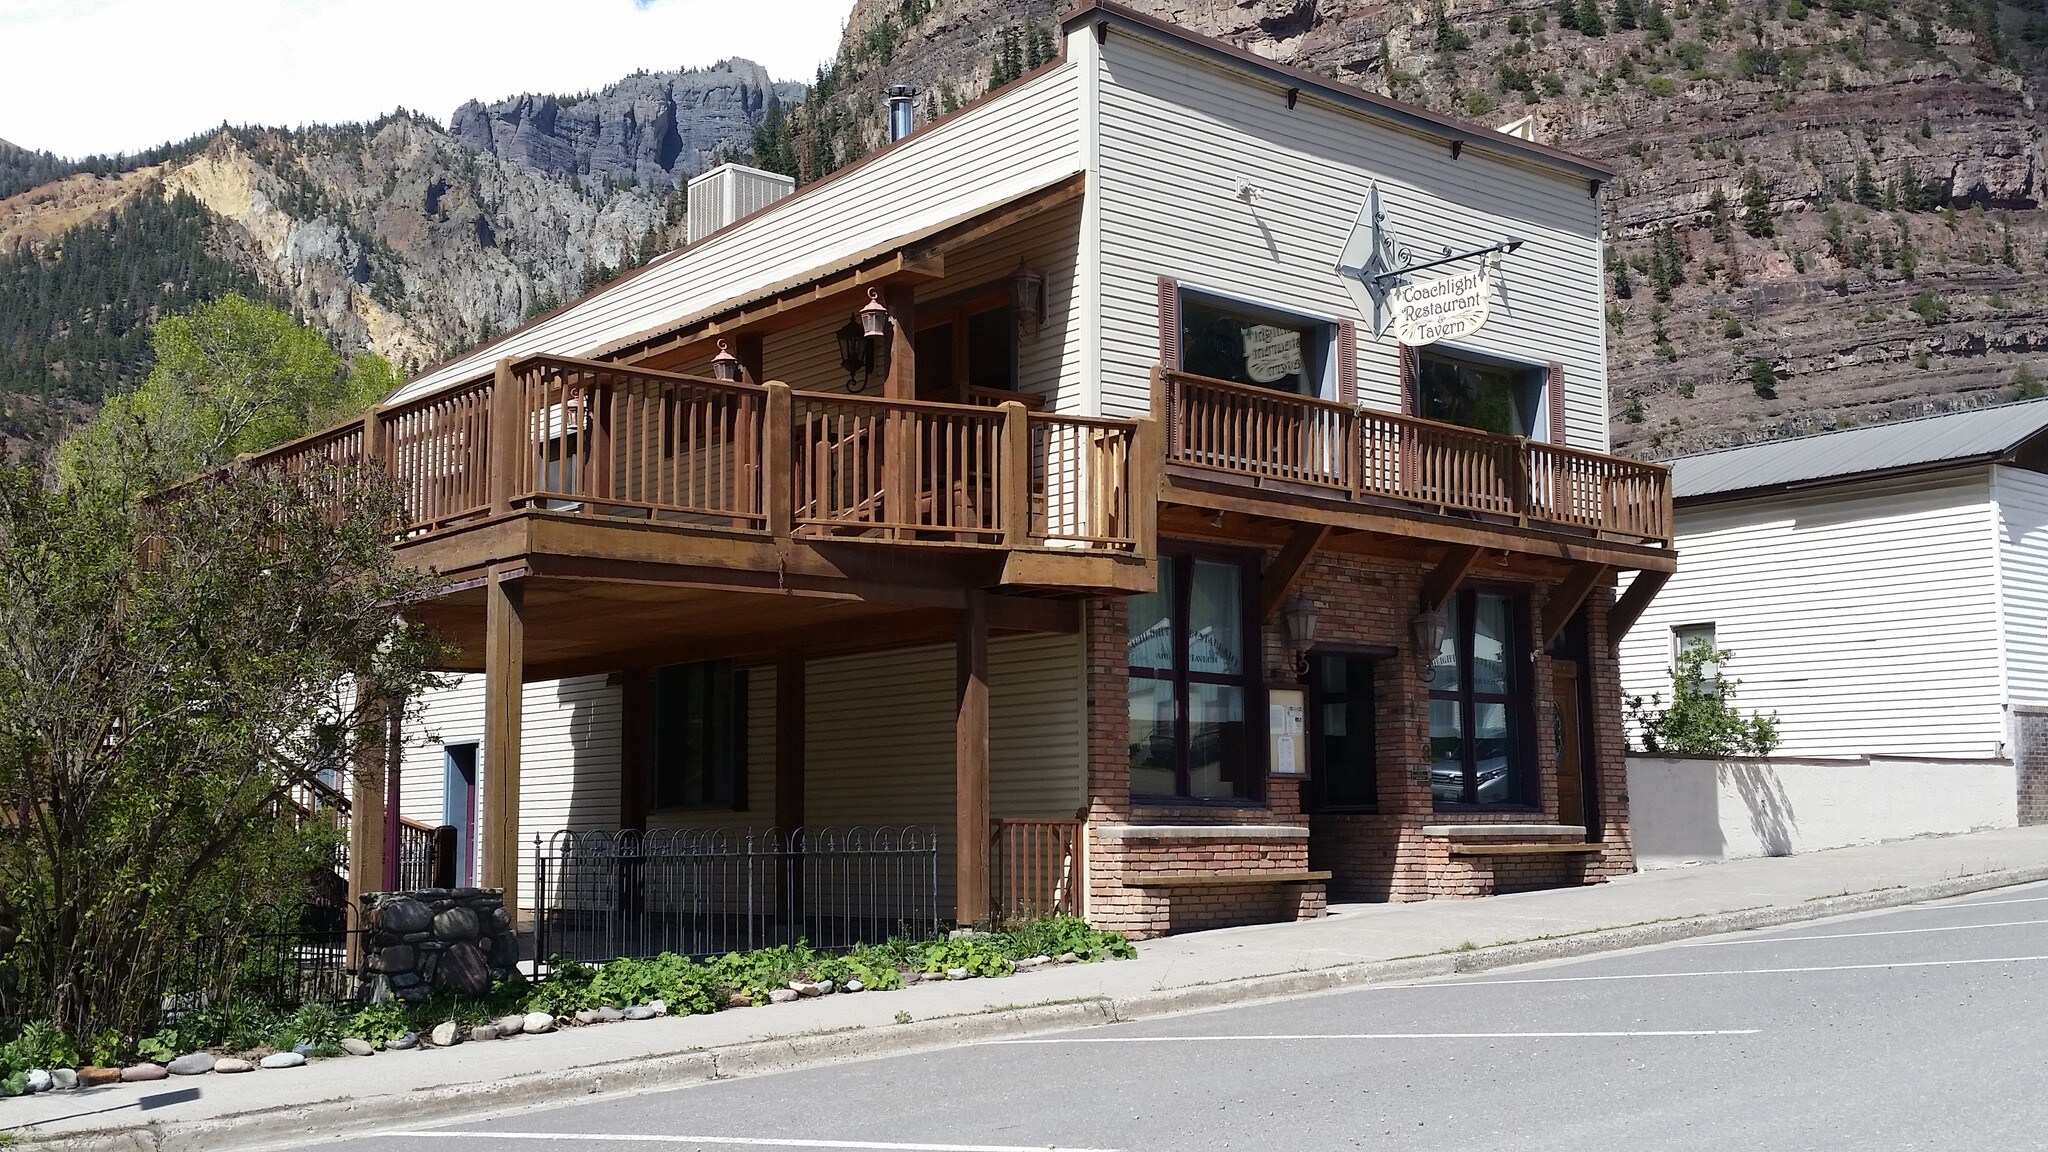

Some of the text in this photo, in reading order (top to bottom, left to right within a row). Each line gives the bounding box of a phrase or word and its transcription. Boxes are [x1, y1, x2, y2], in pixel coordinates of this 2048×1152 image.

[1402, 274, 1477, 303] Coachlight
[1402, 292, 1480, 322] Restaurant
[1437, 314, 1446, 324] &
[1417, 320, 1465, 340] Tavern
